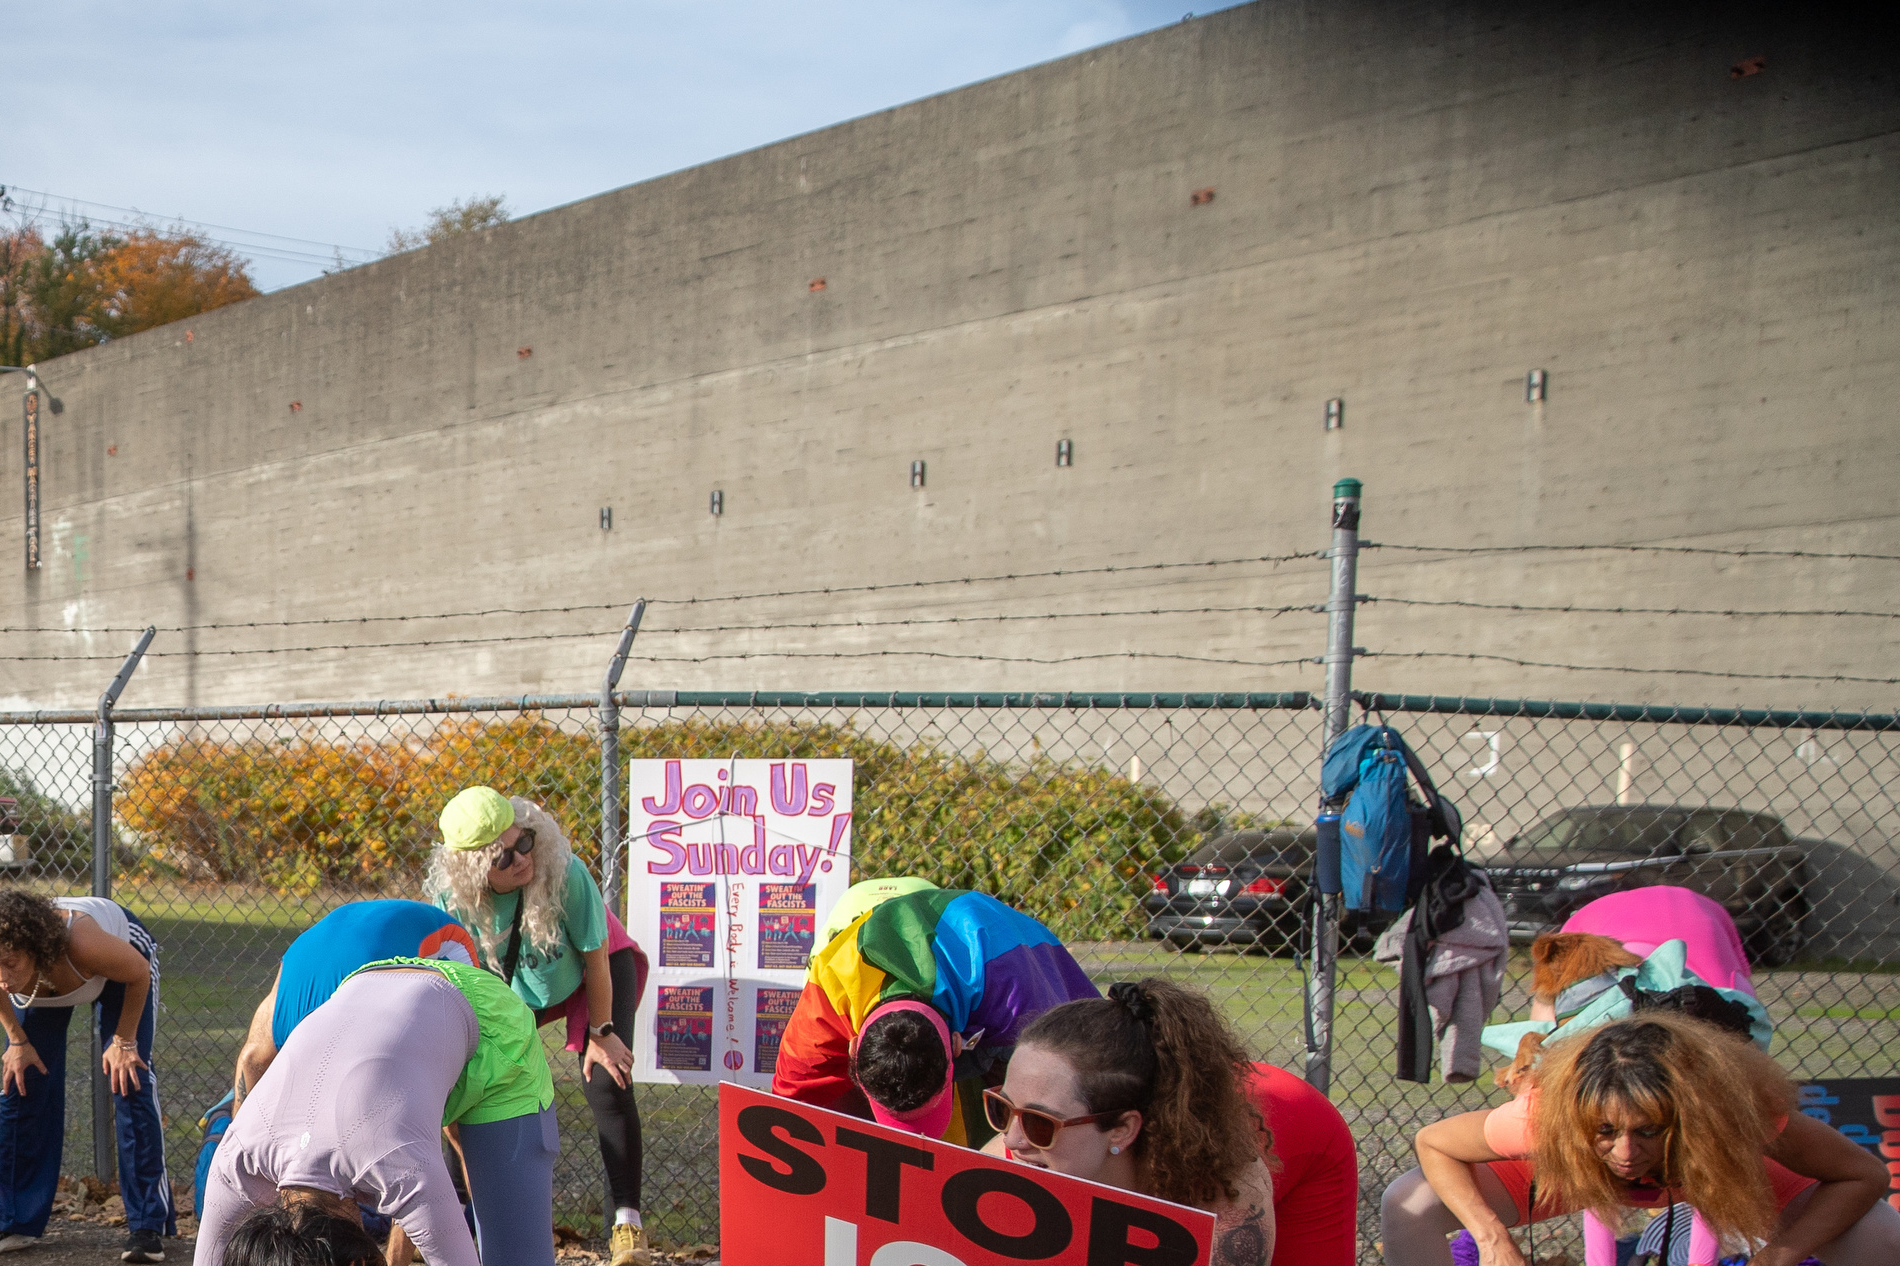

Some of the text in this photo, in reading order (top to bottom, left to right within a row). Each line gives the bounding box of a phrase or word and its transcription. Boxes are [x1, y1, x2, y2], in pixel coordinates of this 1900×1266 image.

[642, 760, 836, 818] Join Us
[646, 812, 850, 884] Sunday!
[766, 885, 804, 893] SWEATIN
[668, 899, 707, 907] FASCISTS
[728, 882, 744, 917] Every
[767, 900, 806, 908] FASCISTS
[727, 924, 743, 953] Body
[730, 960, 739, 968] is
[763, 990, 801, 998] SWEATIN
[665, 1003, 704, 1011] FASCISTS
[765, 1005, 796, 1014] FASCIS
